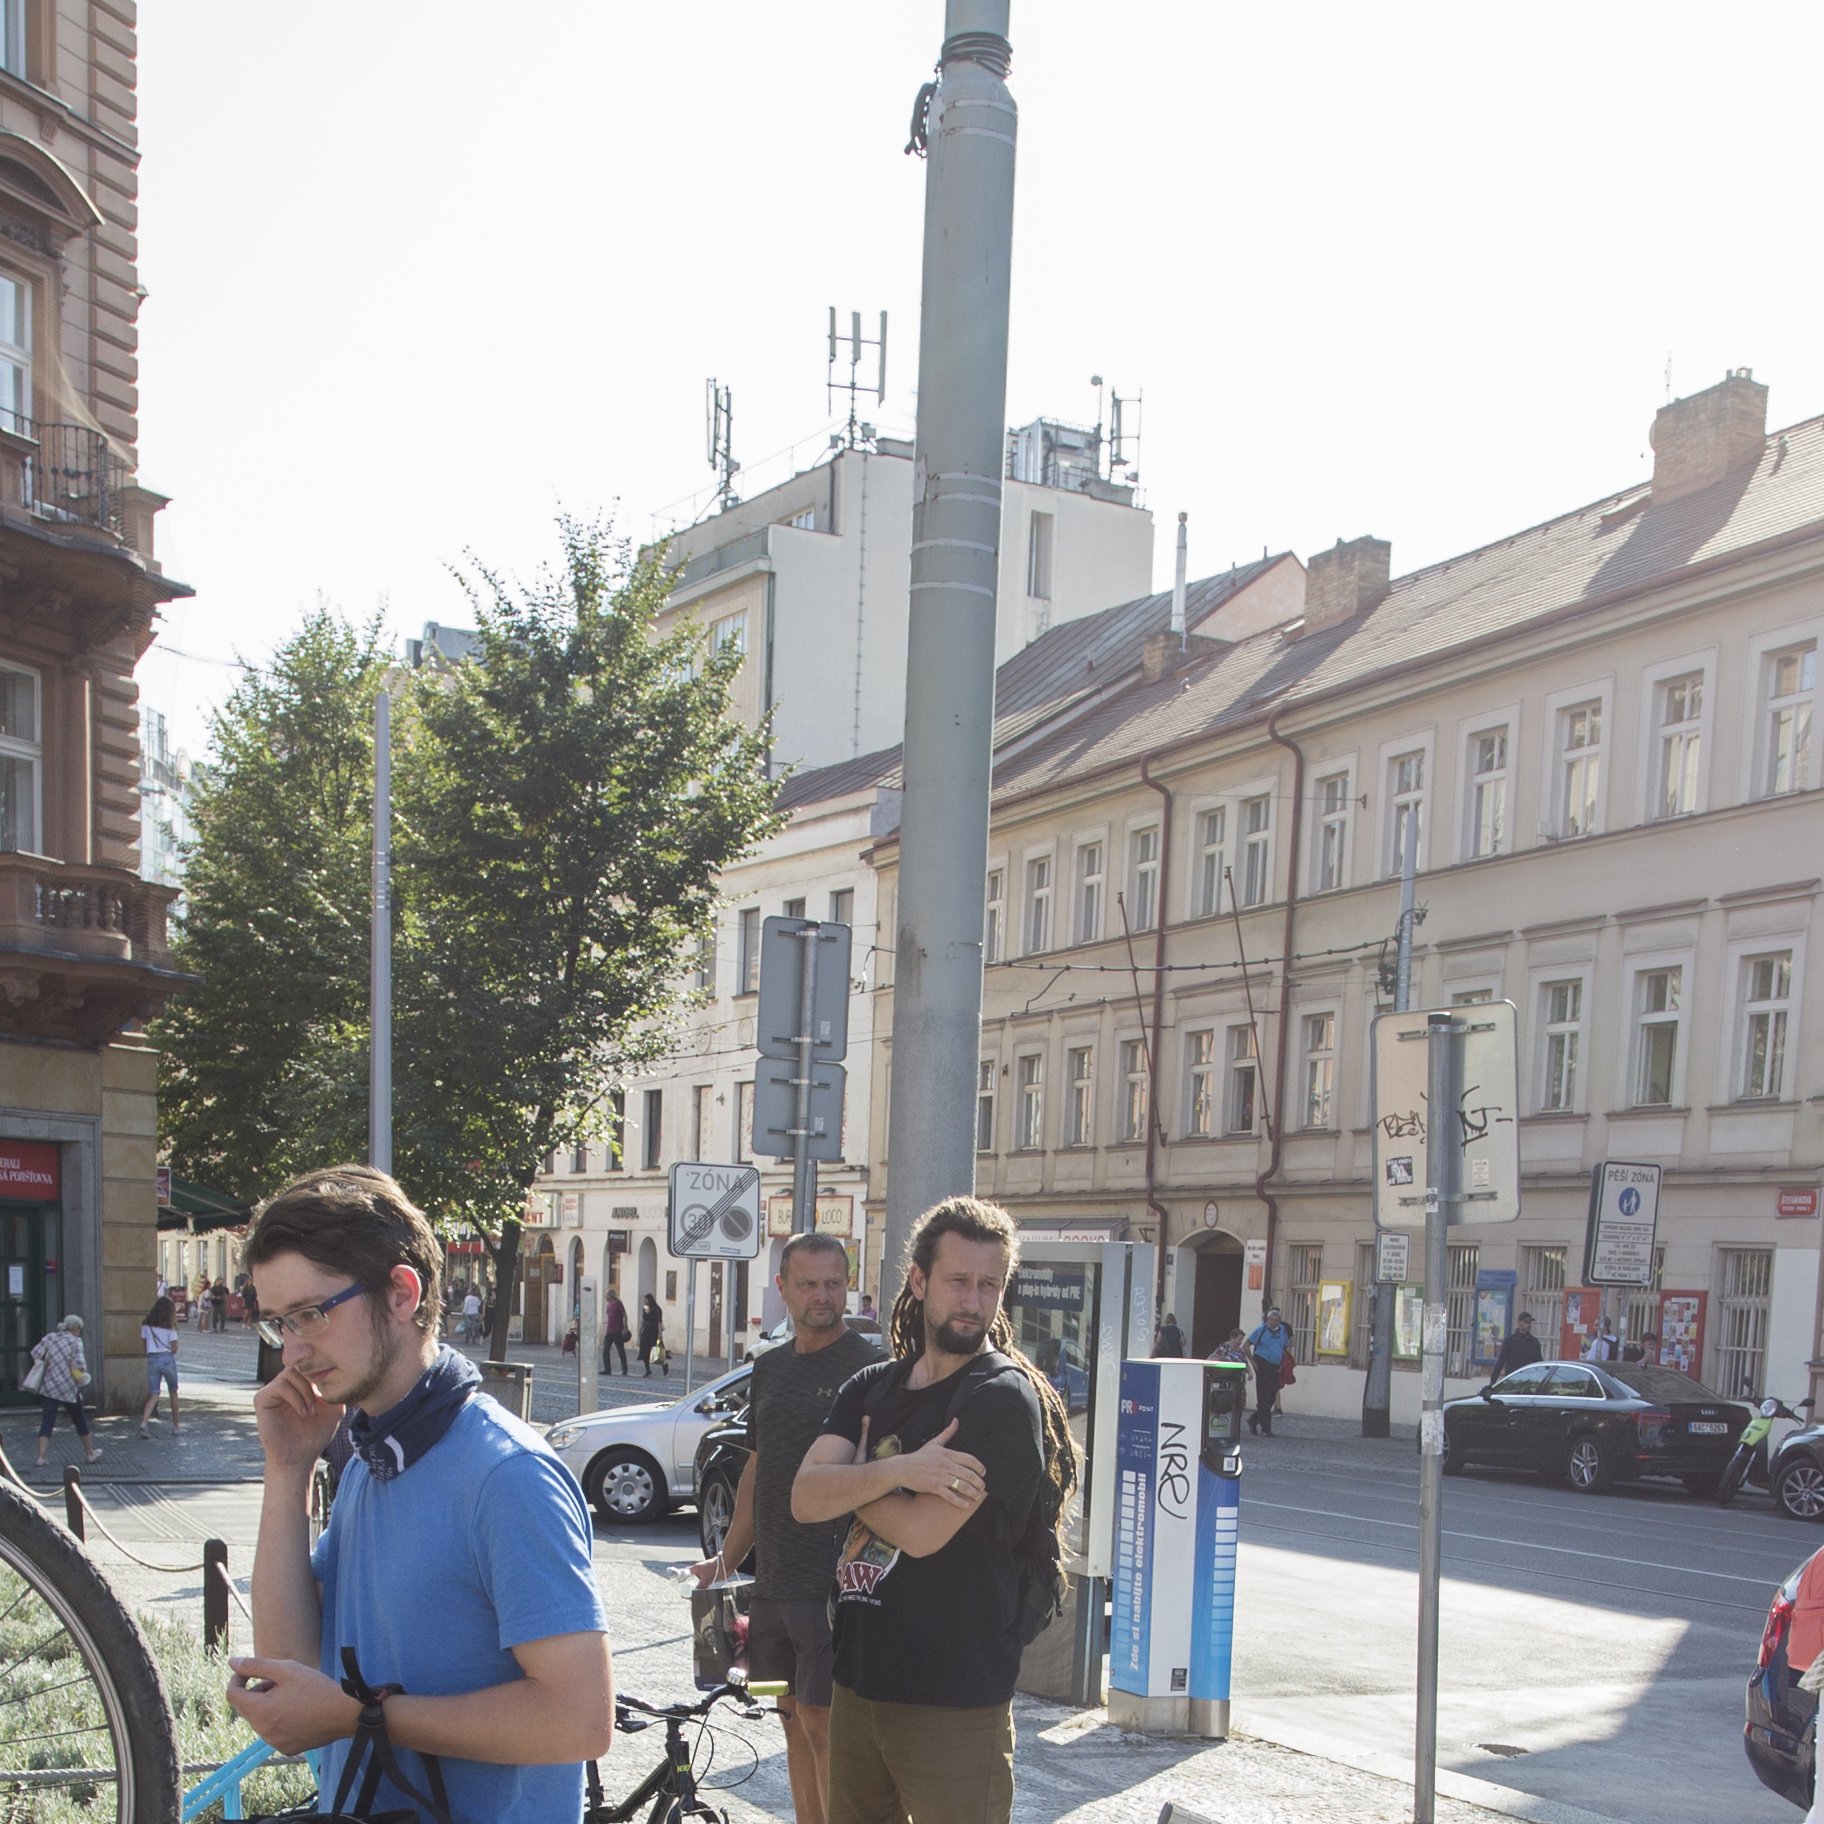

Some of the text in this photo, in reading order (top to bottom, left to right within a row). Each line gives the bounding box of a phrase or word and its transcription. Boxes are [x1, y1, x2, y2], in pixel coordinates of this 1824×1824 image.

[9, 1169, 53, 1185] POJIŠŤOVNA
[1608, 1168, 1655, 1184] PĚŠÍ ZÓNA
[821, 1208, 843, 1225] LOCO
[1138, 1405, 1154, 1413] POINT
